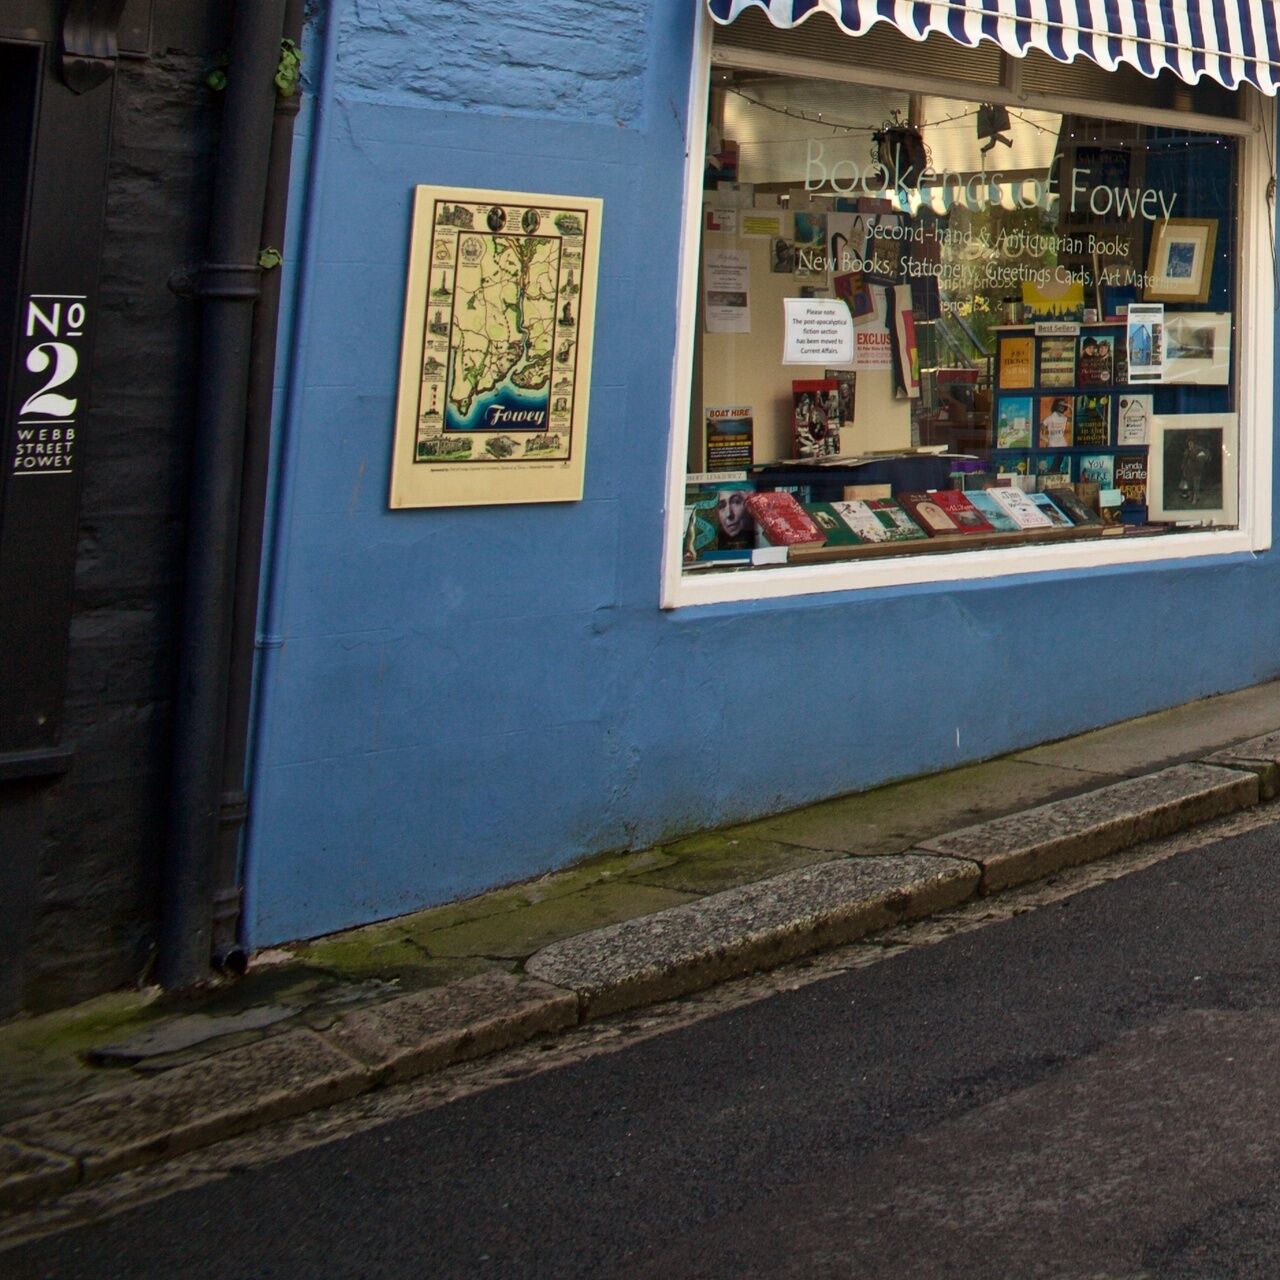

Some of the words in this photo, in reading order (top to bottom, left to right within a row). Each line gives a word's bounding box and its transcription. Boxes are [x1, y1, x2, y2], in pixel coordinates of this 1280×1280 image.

[804, 139, 1004, 213] Bookends
[1017, 153, 1065, 213] of
[1070, 167, 1177, 238] Fowey
[865, 217, 973, 245] Second-hand
[980, 226, 991, 248] &
[995, 226, 1083, 254] Antiquarian
[1088, 234, 1129, 257] Books
[798, 249, 836, 271] New
[842, 251, 894, 276] Books,
[985, 261, 1050, 289] Greetings
[1054, 264, 1094, 287] Cards,
[1098, 267, 1121, 287] Art
[1038, 324, 1055, 332] Best
[1056, 324, 1077, 332] Sellers
[19, 342, 78, 417] 2
[484, 404, 545, 426] Fowey
[710, 409, 729, 417] BOAT
[731, 408, 750, 417] HIRE
[17, 428, 76, 441] WEBB
[16, 441, 74, 455] STREET
[14, 455, 73, 468] FOWEY
[1121, 462, 1143, 471] Lynda
[1116, 469, 1147, 480] Plante
